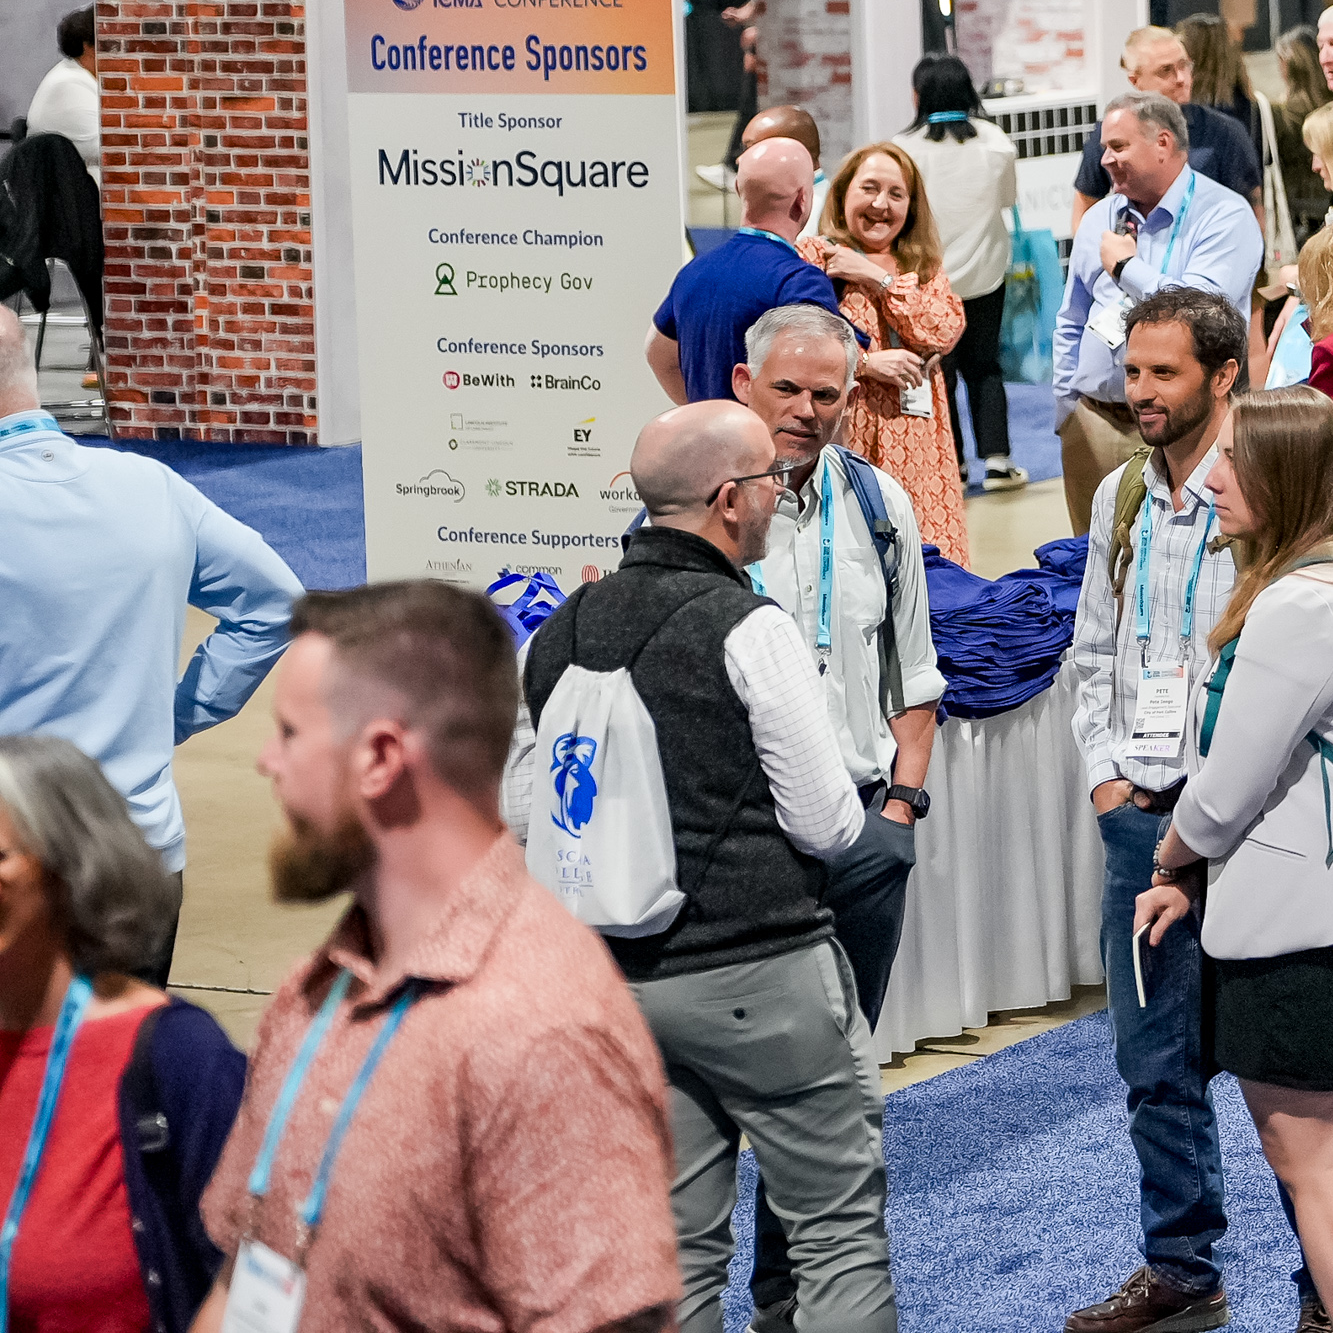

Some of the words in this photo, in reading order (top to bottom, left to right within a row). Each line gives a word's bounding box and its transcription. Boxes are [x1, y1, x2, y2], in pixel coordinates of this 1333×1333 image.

[370, 34, 515, 71] Conference
[525, 34, 648, 81] Sponsors
[458, 112, 493, 128] Title
[498, 113, 563, 131] Sponsor
[428, 228, 518, 246] Conference
[522, 229, 604, 249] Champion
[465, 271, 552, 293] Prophecy
[560, 272, 593, 290] Gov
[436, 337, 527, 356] Conference
[531, 340, 604, 358] Sponsors
[462, 373, 516, 388] BeWith
[545, 375, 601, 391] BrainCo
[573, 429, 592, 443] EY
[396, 482, 461, 498] Springbrook
[505, 480, 580, 498] STRADA
[437, 526, 527, 545] Conference
[531, 529, 619, 548] Supporters
[515, 564, 562, 577] common
[1134, 744, 1171, 753] SPEAKER
